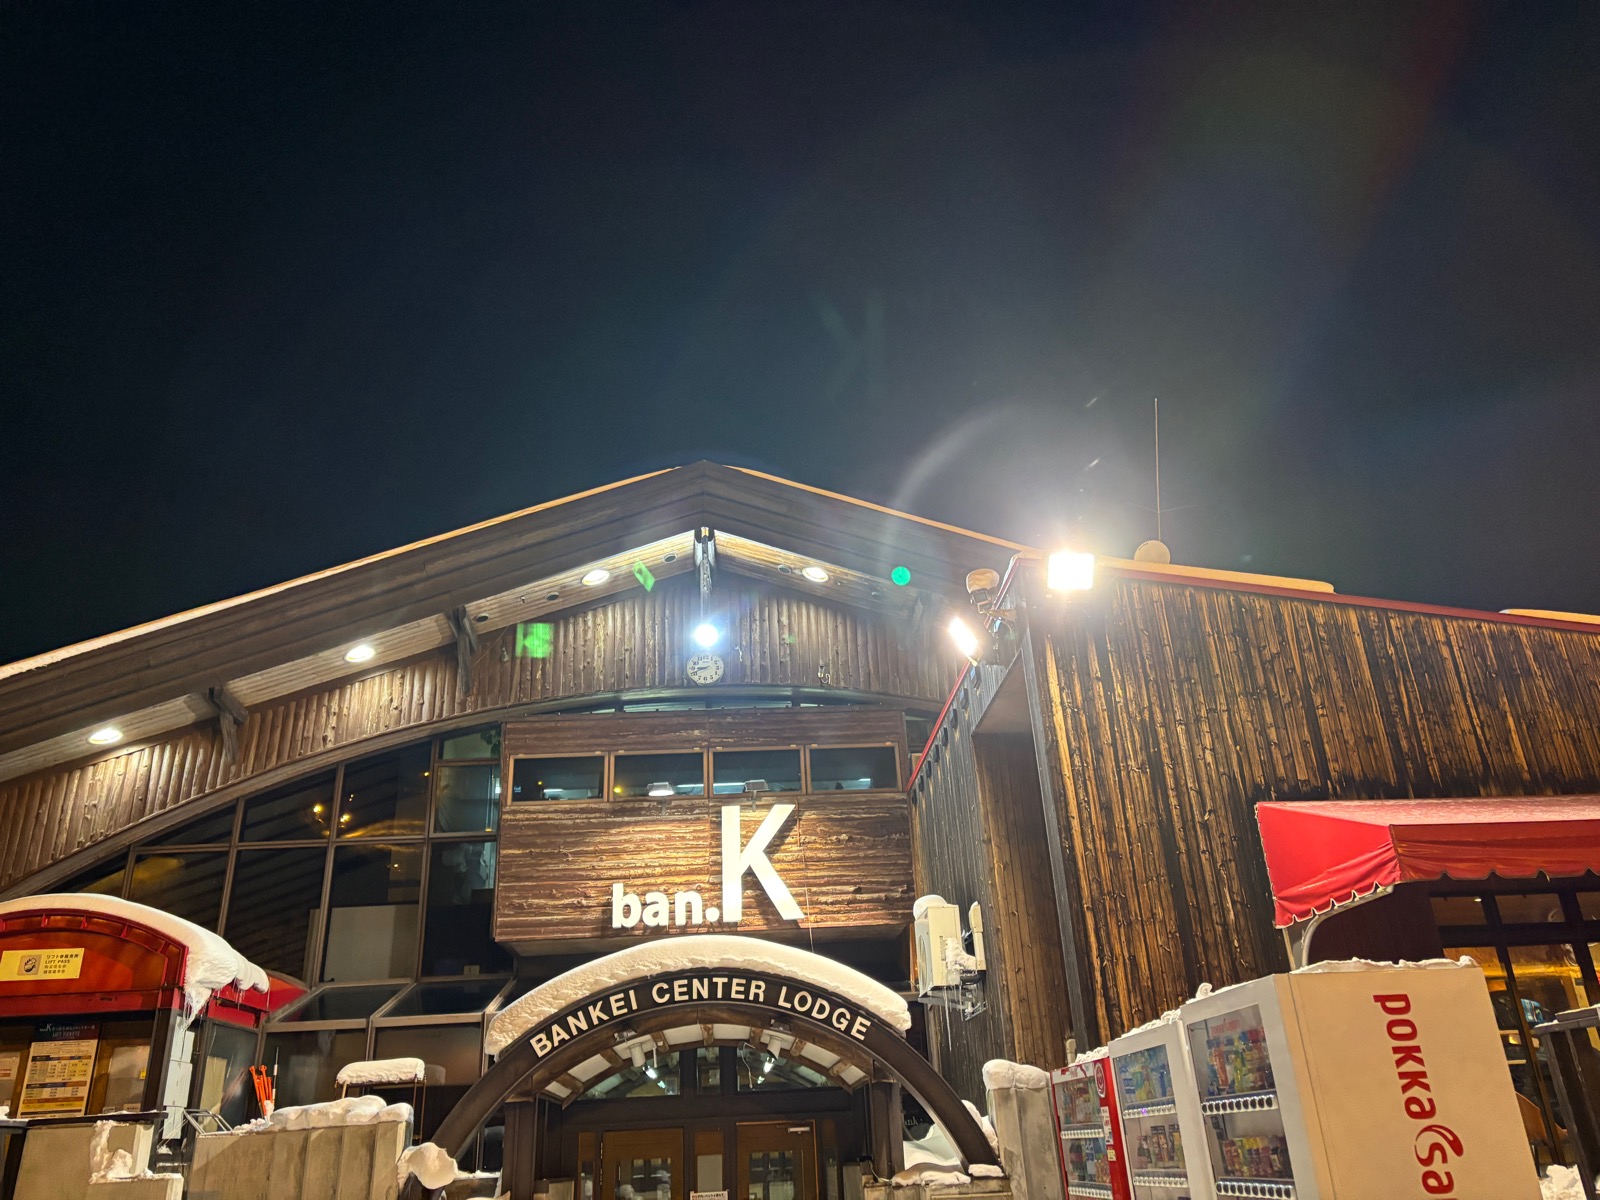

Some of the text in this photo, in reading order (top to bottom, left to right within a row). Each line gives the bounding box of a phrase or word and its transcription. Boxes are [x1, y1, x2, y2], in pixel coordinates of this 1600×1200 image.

[612, 803, 806, 929] ban.K
[529, 976, 872, 1058] BANKEI CENTER LODGE
